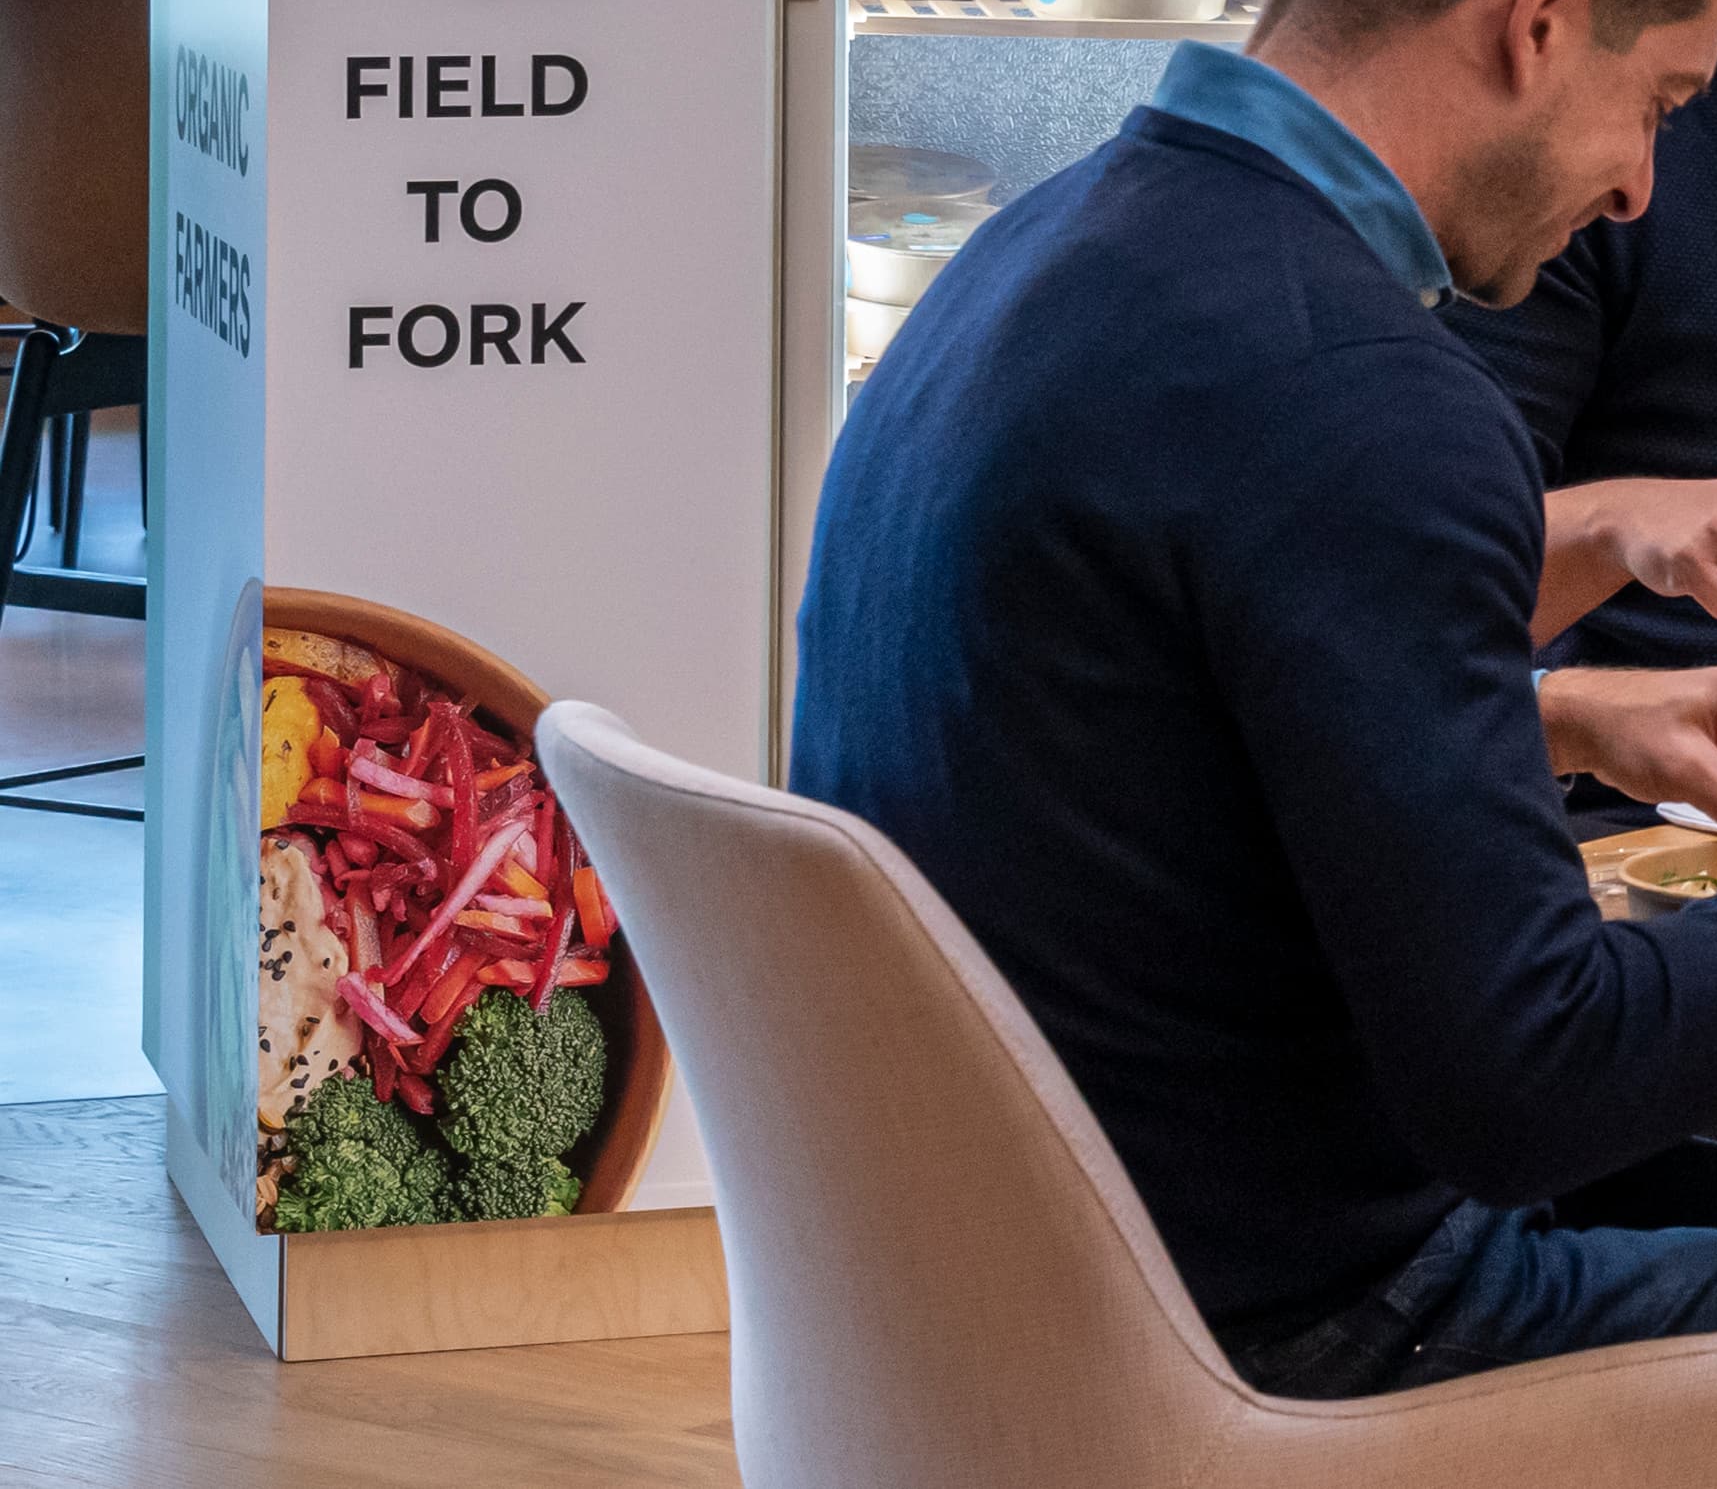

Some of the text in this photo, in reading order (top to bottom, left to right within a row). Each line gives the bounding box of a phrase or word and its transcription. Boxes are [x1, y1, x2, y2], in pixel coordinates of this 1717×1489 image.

[176, 42, 249, 177] ORGANIC
[346, 54, 588, 119] FIELD
[406, 178, 522, 243] TO
[176, 210, 250, 359] FARMERS
[349, 301, 587, 369] FORK
